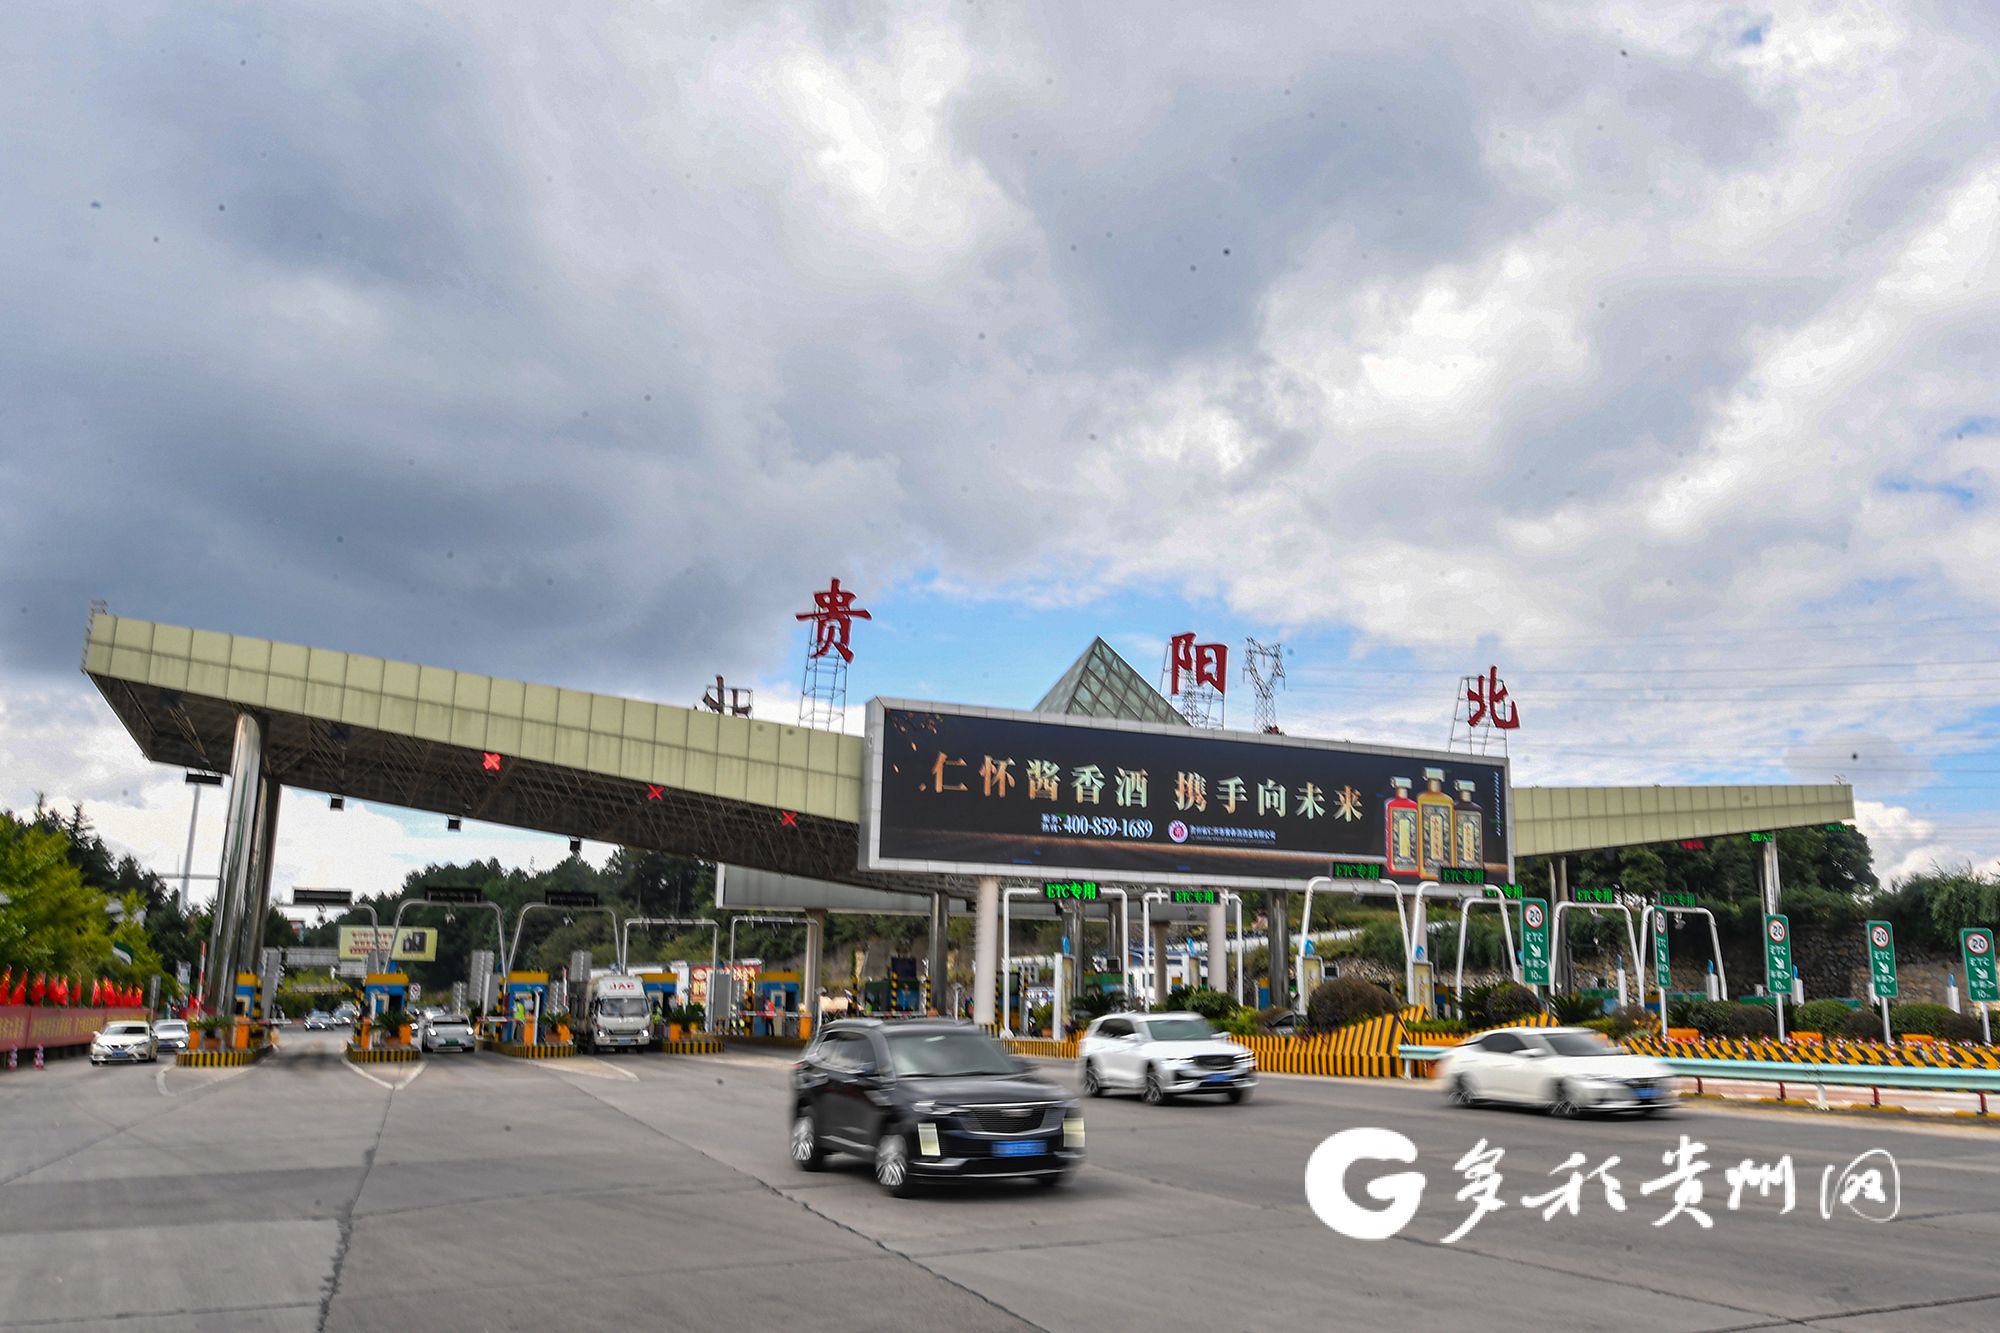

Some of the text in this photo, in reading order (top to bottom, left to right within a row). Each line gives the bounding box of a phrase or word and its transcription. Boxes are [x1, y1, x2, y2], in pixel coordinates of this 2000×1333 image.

[931, 751, 1364, 823] 仁怀酱香酒 携手向未来
[1063, 814, 1153, 838] 400-859-1689
[1525, 930, 1544, 943] ETC
[1770, 944, 1787, 955] ETC
[1873, 950, 1890, 961] ETC
[1968, 956, 1991, 967] ETC
